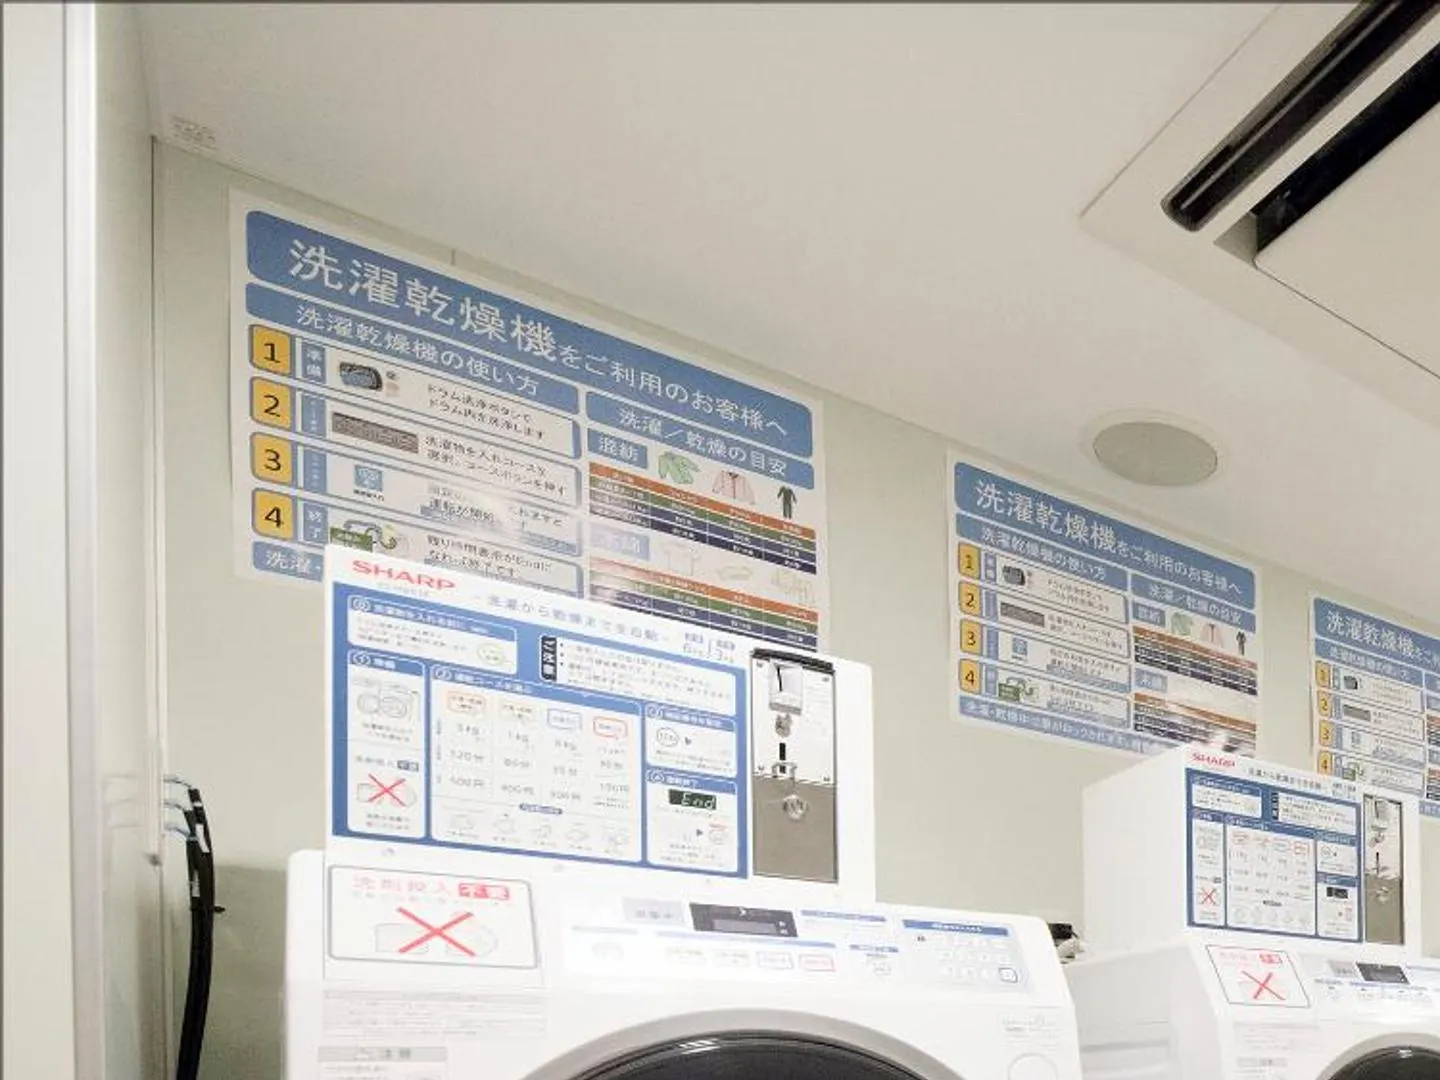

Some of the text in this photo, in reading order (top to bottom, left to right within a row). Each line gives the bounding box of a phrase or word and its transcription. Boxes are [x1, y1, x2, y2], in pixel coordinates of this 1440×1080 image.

[289, 239, 788, 438] 洗濯乾燥機をご利用のお客様へ
[263, 342, 281, 364] 1
[296, 305, 540, 397] 洗濯乾燥機の使い方
[263, 395, 282, 418] 2
[264, 449, 282, 472] 3
[264, 506, 283, 528] 4
[976, 479, 1243, 597] 洗濯乾燥機をご利用のお客様へ
[963, 554, 975, 571] 1
[981, 527, 1106, 581] 洗濯乾燥機の使い方
[352, 559, 456, 590] SHARP
[965, 593, 976, 609] 2
[965, 630, 977, 646] 3
[964, 671, 976, 686] 4
[682, 791, 715, 811] End
